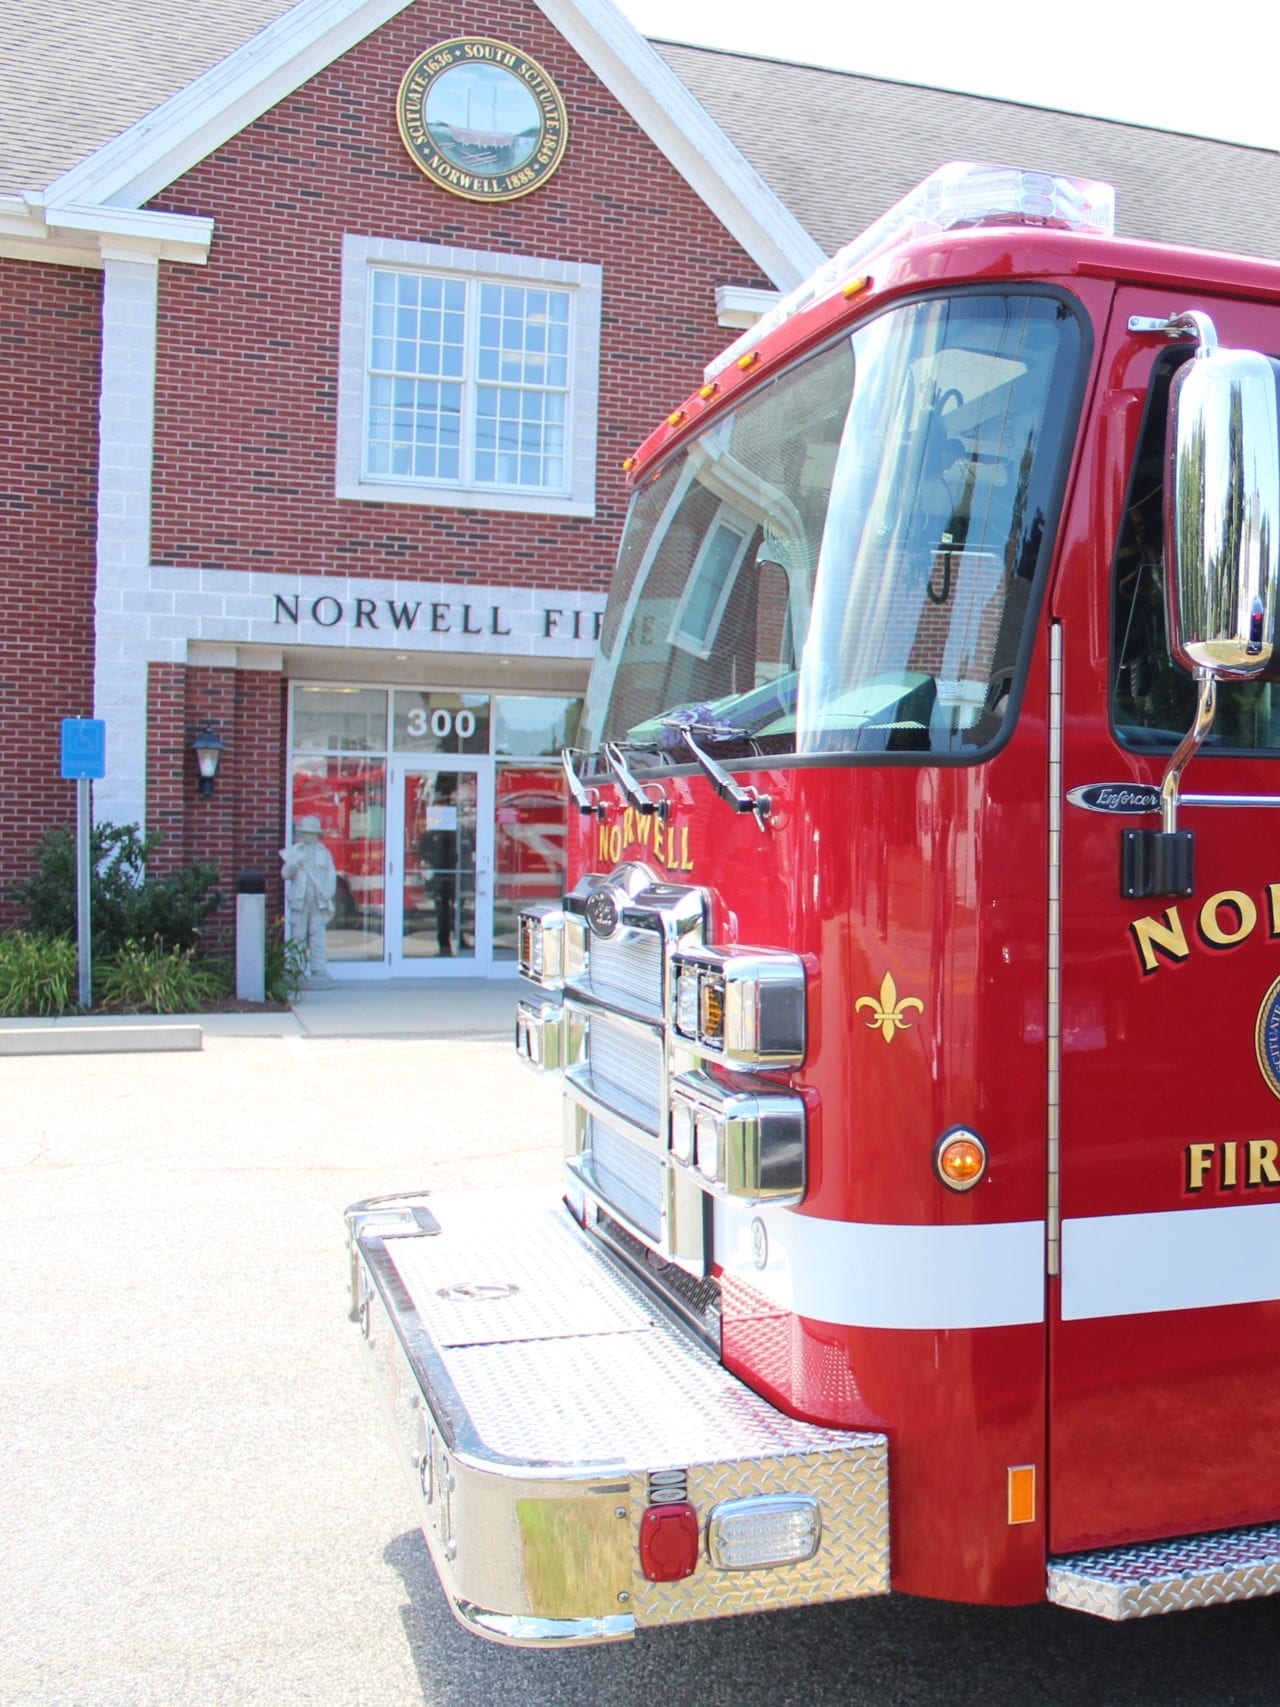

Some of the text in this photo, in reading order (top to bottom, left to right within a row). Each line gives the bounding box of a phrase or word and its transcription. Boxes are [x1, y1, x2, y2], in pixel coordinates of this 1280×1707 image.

[405, 50, 453, 146] SCITUATE 1636
[464, 43, 560, 164] SOUTH SCITUATE 1849
[428, 156, 535, 193] NORWELL 1888
[273, 593, 511, 636] NORWELL
[407, 707, 476, 738] 300
[1096, 788, 1158, 809] Enforcer
[599, 806, 694, 872] NORWELL
